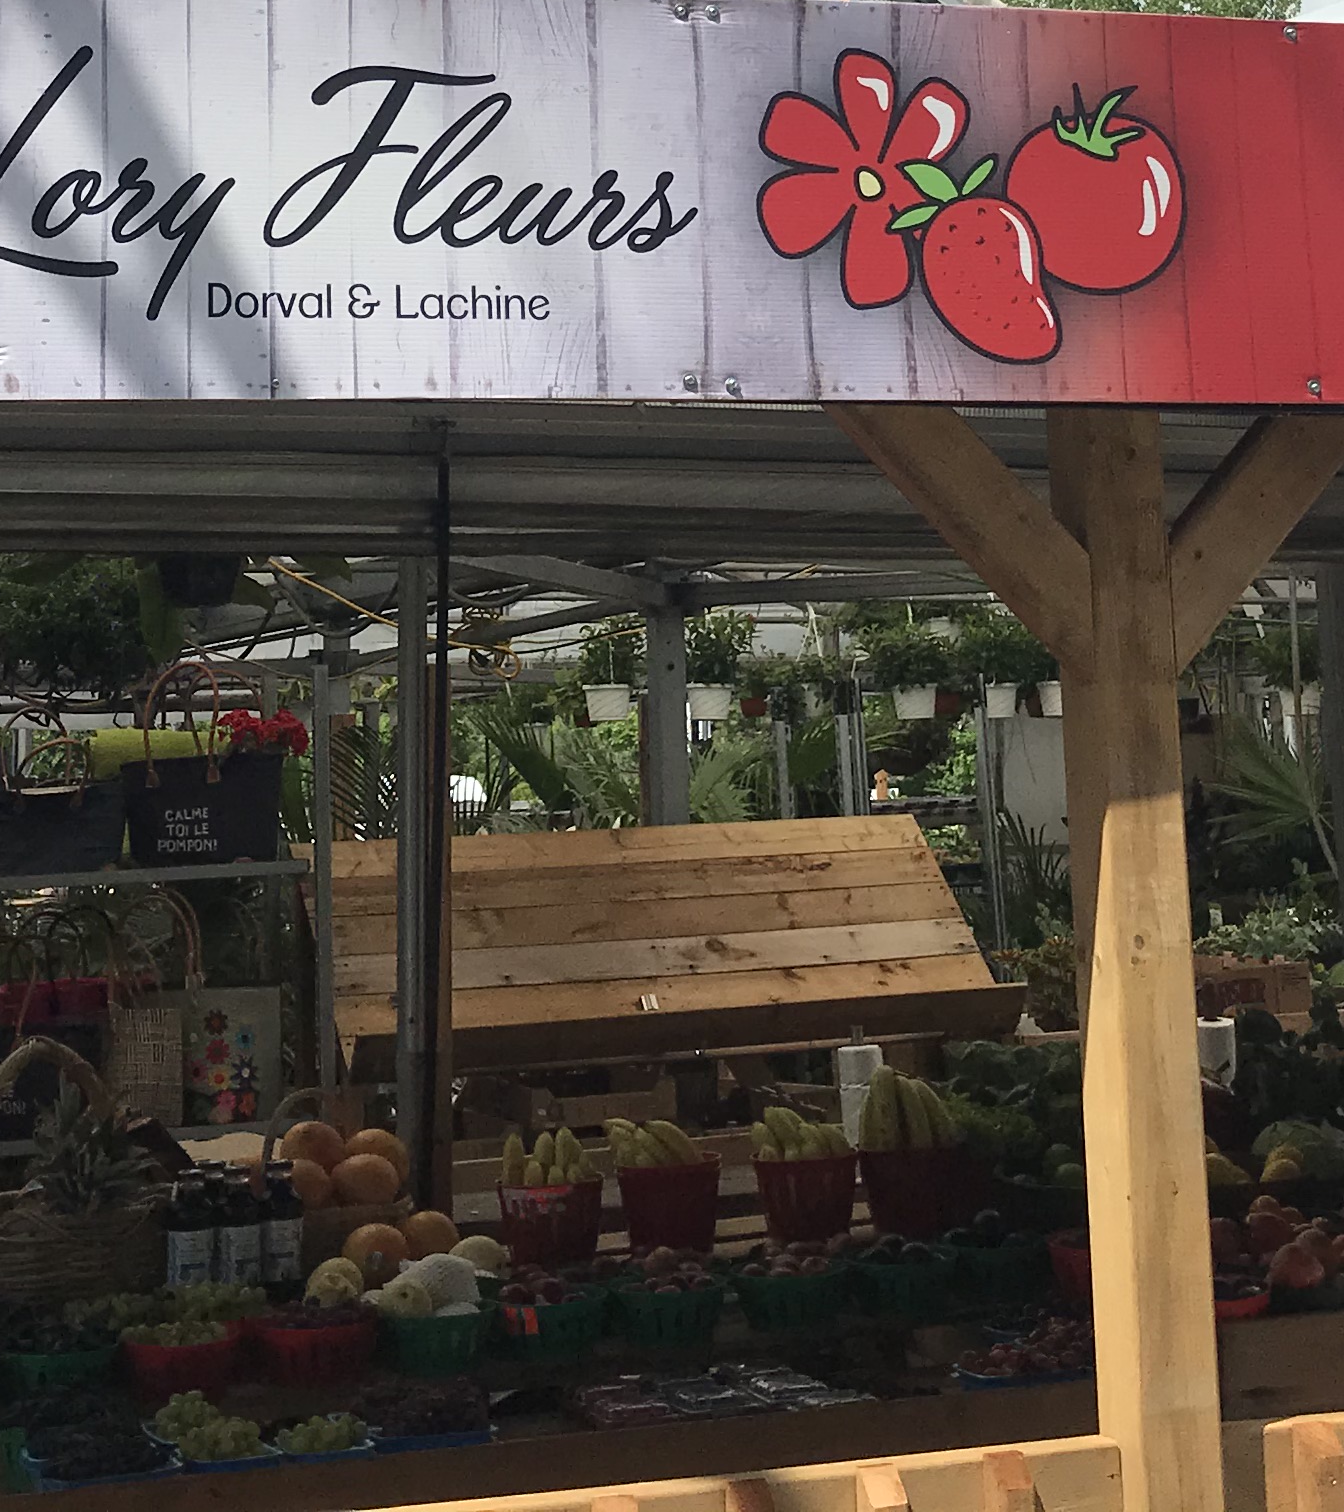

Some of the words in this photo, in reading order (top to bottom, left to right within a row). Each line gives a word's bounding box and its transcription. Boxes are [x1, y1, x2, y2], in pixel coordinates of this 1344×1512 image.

[263, 65, 699, 253] Fleurs
[207, 282, 334, 320] Dorval
[347, 284, 381, 320] &
[395, 283, 551, 321] Lachine
[164, 806, 209, 822] CALME
[165, 824, 189, 837] TOI
[194, 822, 210, 836] LE
[156, 839, 218, 852] POMPON!
